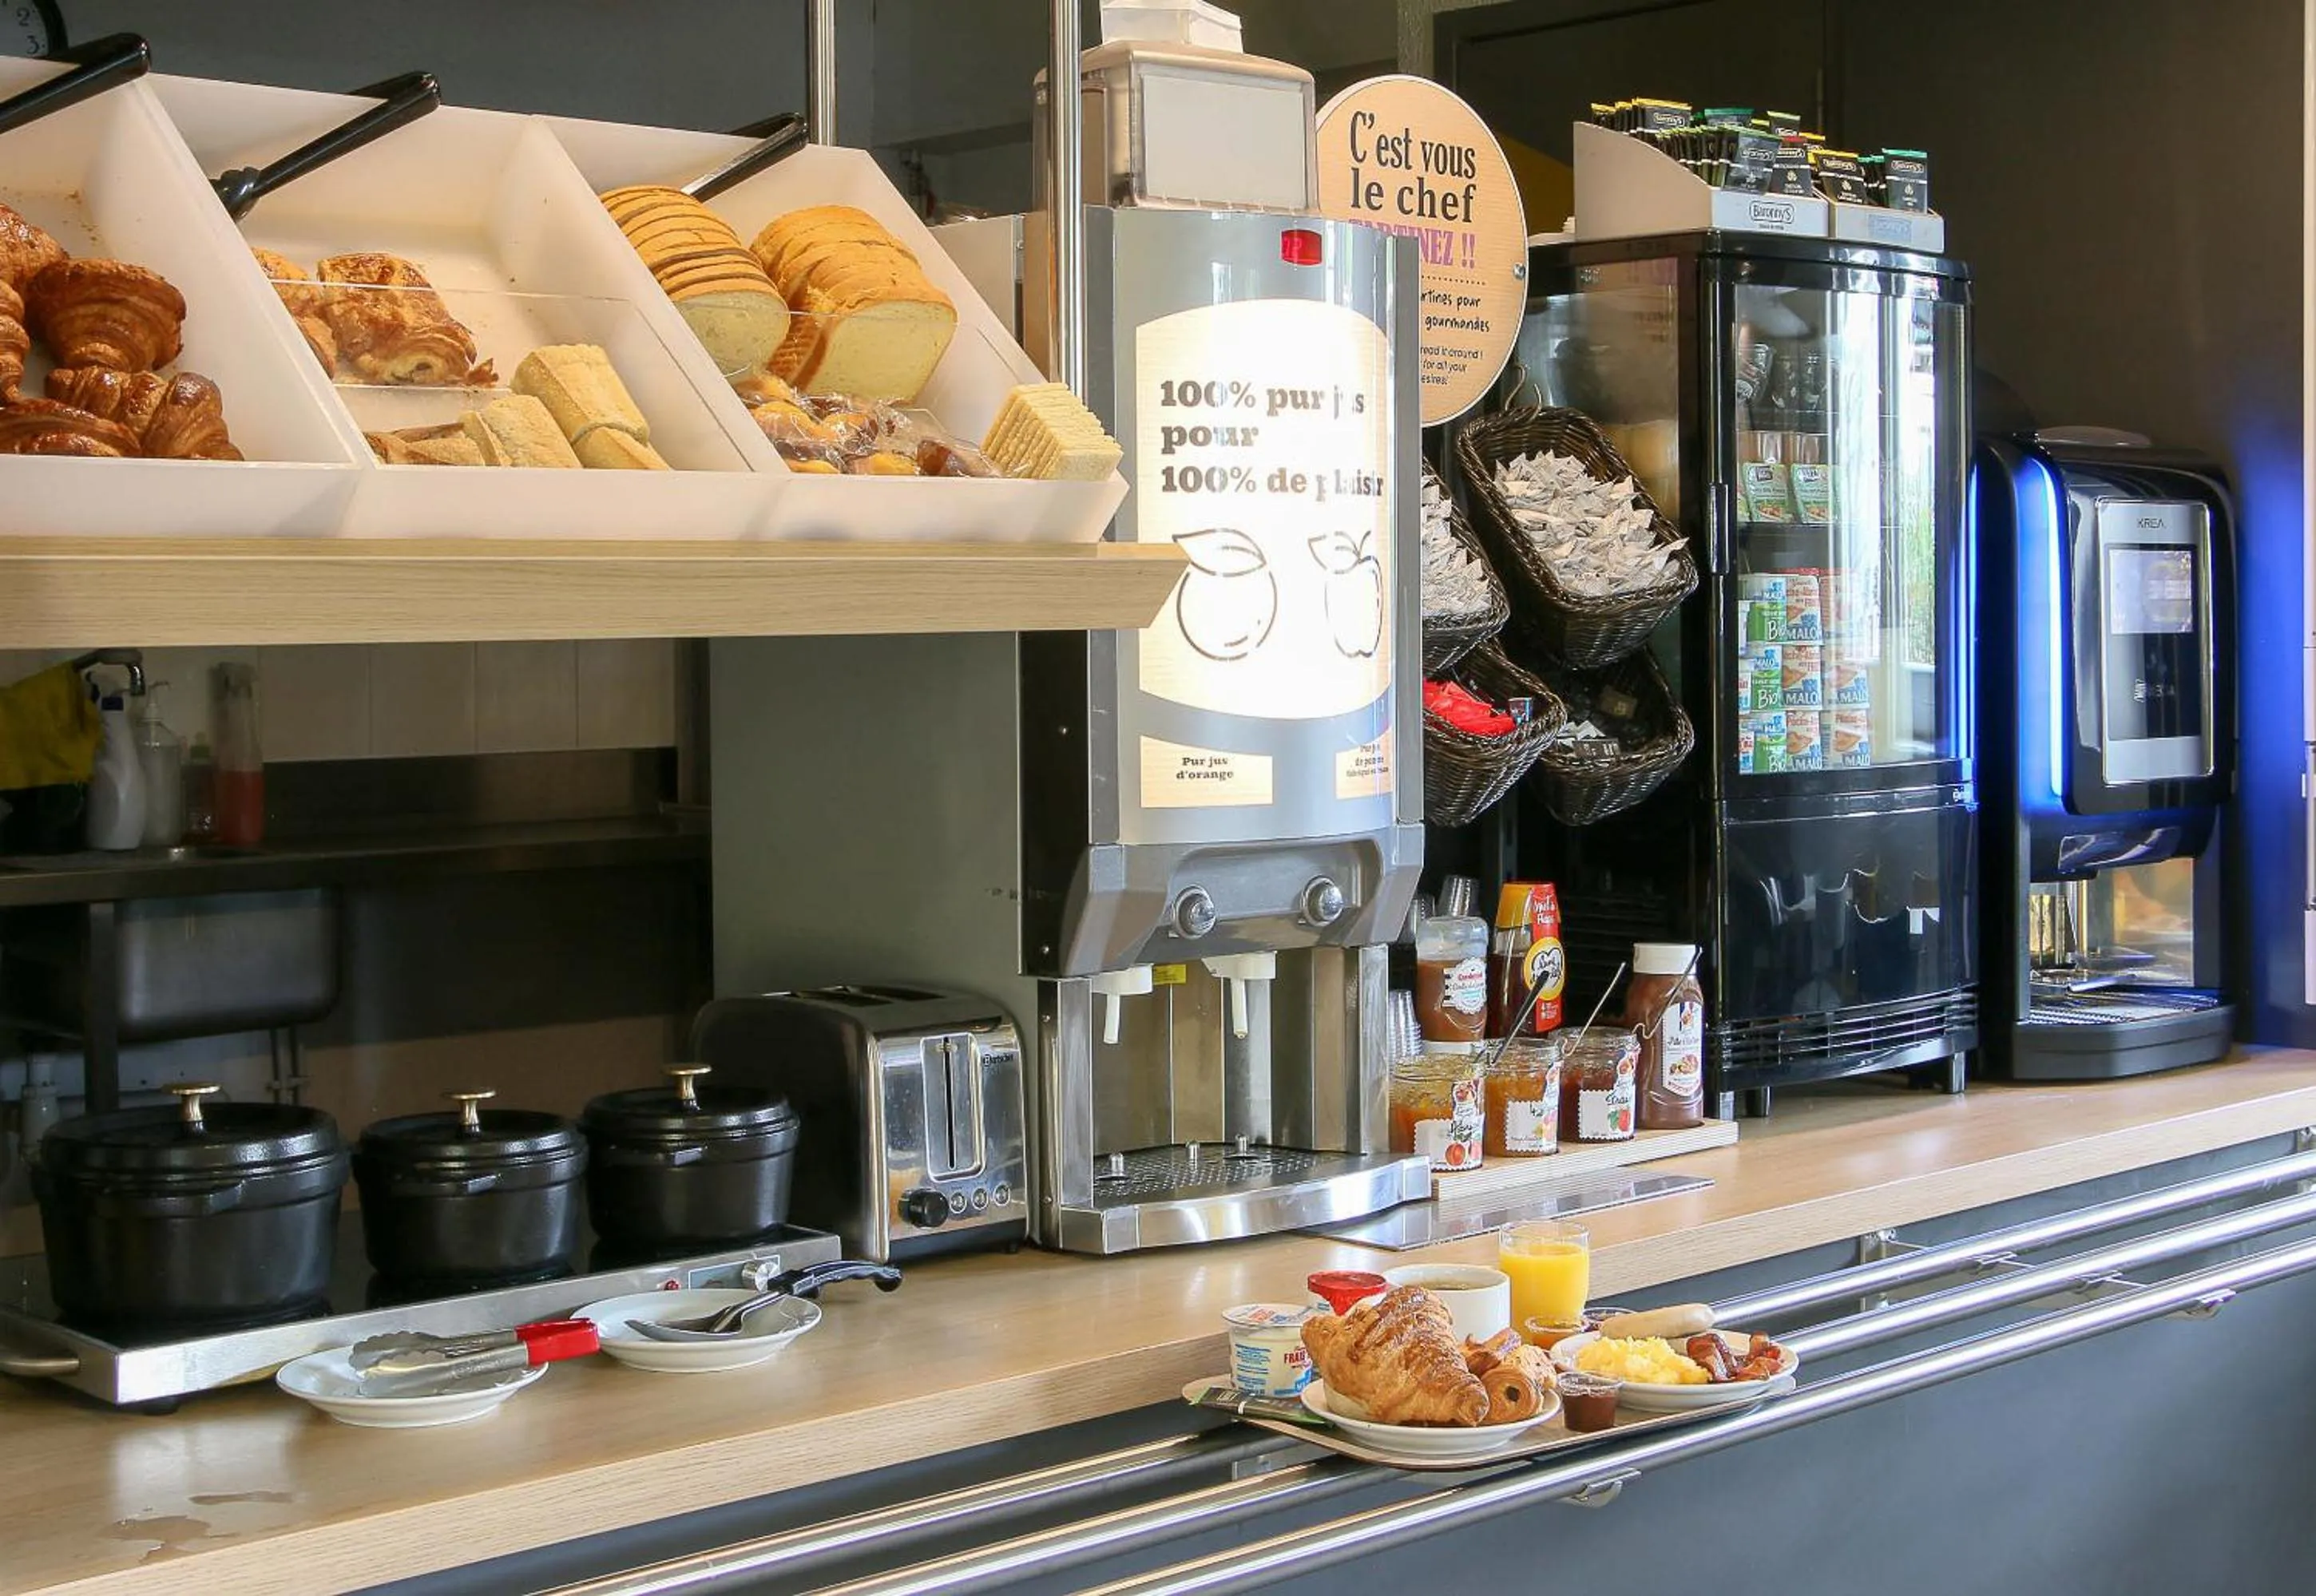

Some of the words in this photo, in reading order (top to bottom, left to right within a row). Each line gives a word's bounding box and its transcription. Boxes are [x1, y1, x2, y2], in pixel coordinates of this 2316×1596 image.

[17, 8, 30, 26] 2
[26, 35, 39, 54] 3
[1350, 110, 1412, 170] C'est
[1421, 141, 1476, 180] vous
[1351, 167, 1384, 211] le
[1398, 176, 1477, 223] chef
[1421, 289, 1453, 306] rtines
[1457, 298, 1481, 311] pour
[1425, 315, 1490, 333] gourmandes
[1160, 380, 1256, 408] 100%
[1267, 387, 1325, 417] pur
[1333, 385, 1364, 420] js
[1161, 426, 1259, 454] pour
[1162, 465, 1257, 493] 100%
[1267, 468, 1307, 493] de
[2137, 517, 2164, 529] KREA
[1758, 690, 1779, 709] Bio
[1786, 691, 1818, 706] MALO
[1182, 757, 1205, 766] Pur
[1208, 756, 1228, 767] jus
[1176, 770, 1234, 782] d'orange
